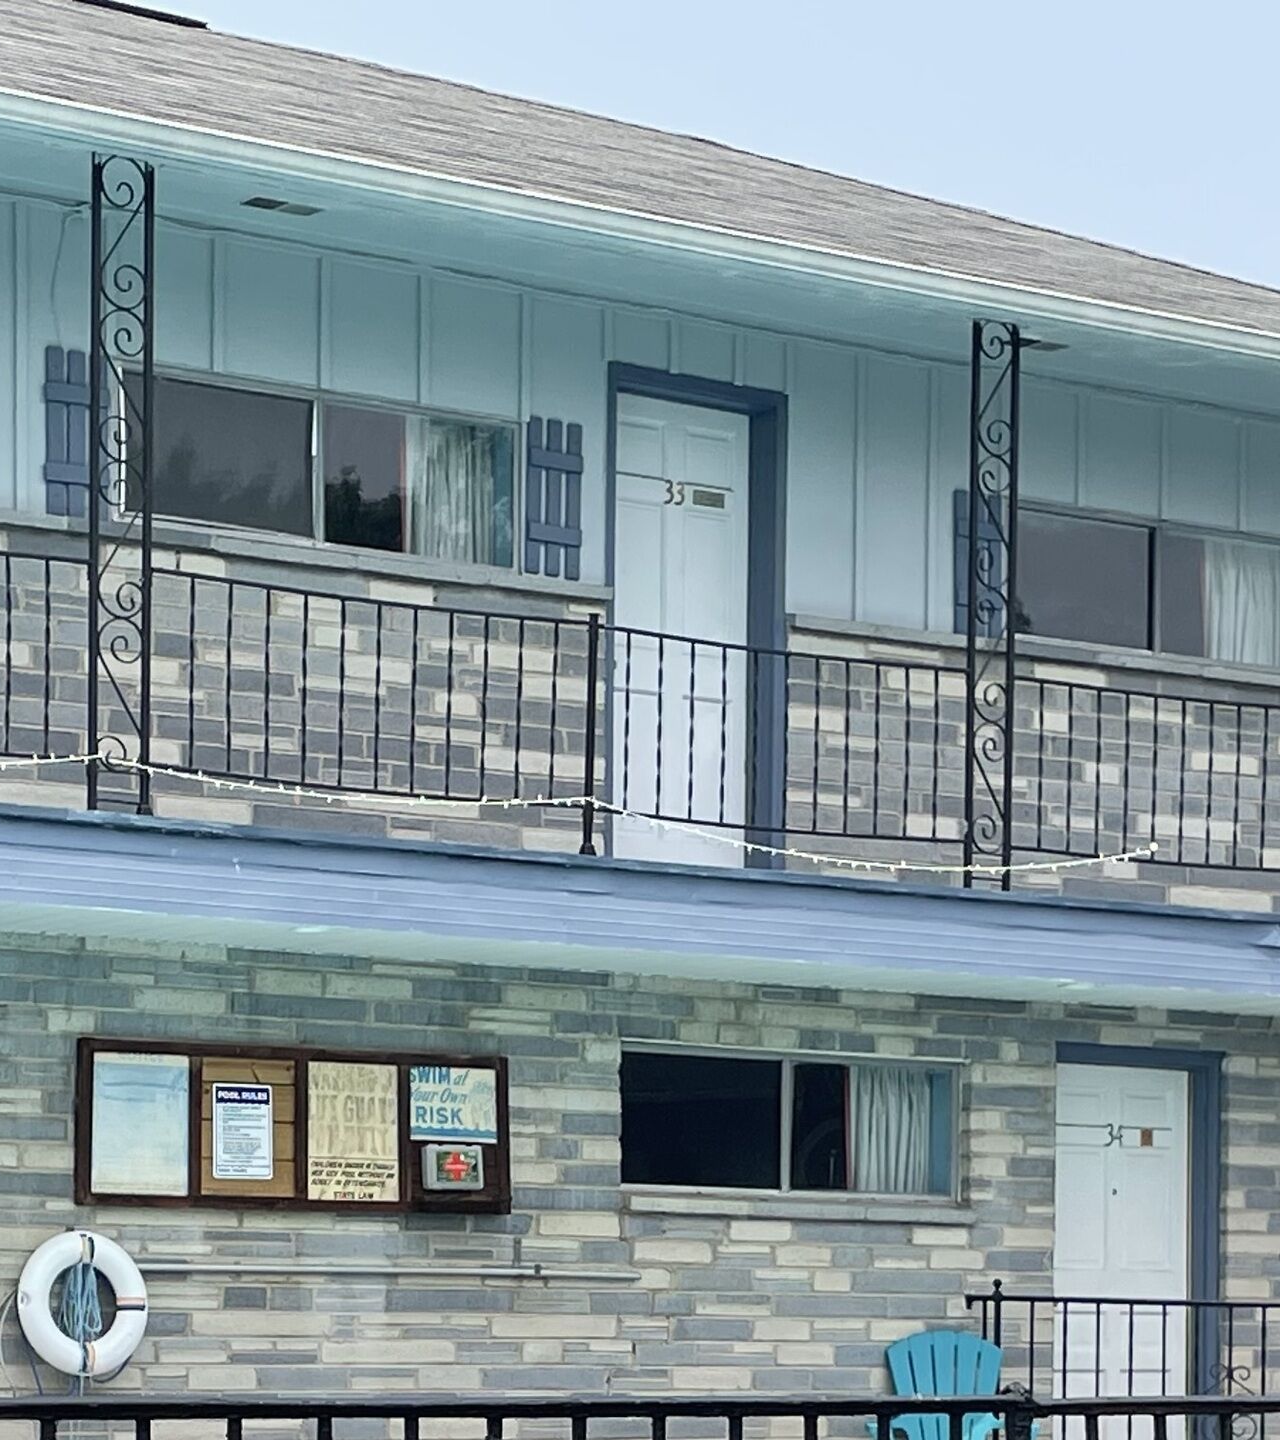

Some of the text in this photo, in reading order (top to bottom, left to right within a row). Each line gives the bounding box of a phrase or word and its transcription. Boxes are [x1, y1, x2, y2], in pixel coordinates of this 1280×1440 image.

[663, 479, 685, 506] 33
[410, 1066, 451, 1085] SWIM
[218, 1091, 268, 1101] POOL RULES
[440, 1087, 468, 1104] Own
[415, 1105, 464, 1125] RISK
[1103, 1122, 1123, 1148] 34
[333, 1190, 374, 1200] STATE LAW
